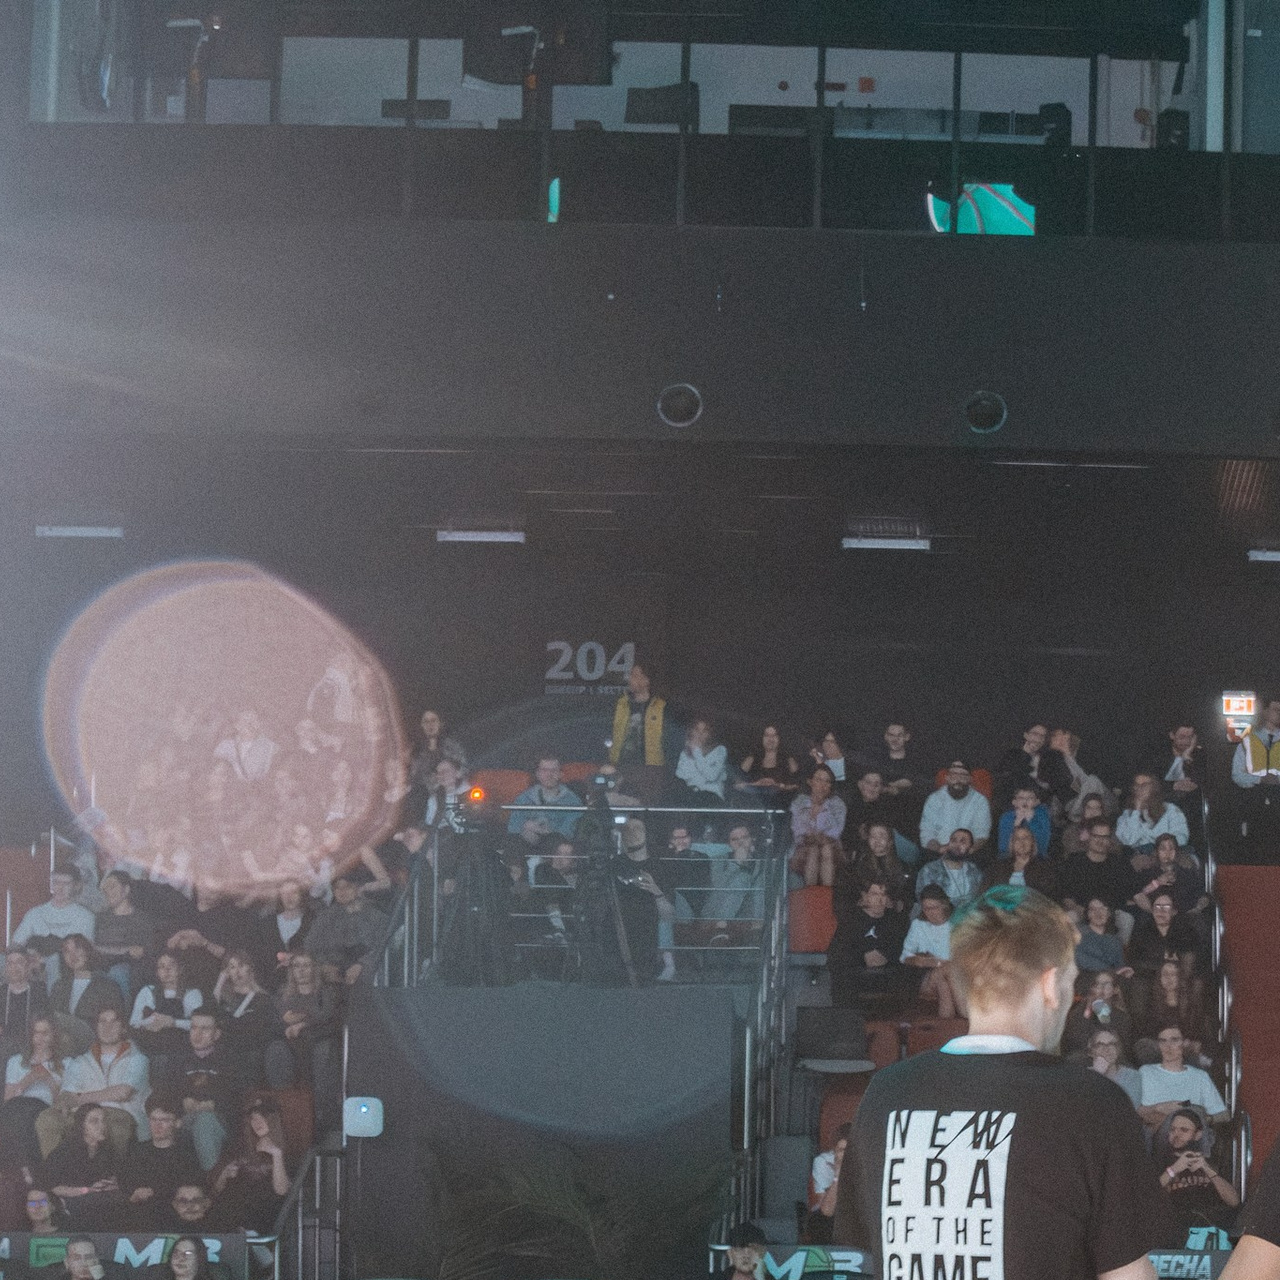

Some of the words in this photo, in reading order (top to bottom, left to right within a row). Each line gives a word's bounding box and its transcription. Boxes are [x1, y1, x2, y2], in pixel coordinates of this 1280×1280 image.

[545, 640, 635, 681] 204
[891, 1110, 1004, 1152] NEW
[887, 1158, 992, 1208] ERA
[887, 1216, 916, 1243] OF
[933, 1217, 993, 1246] THE
